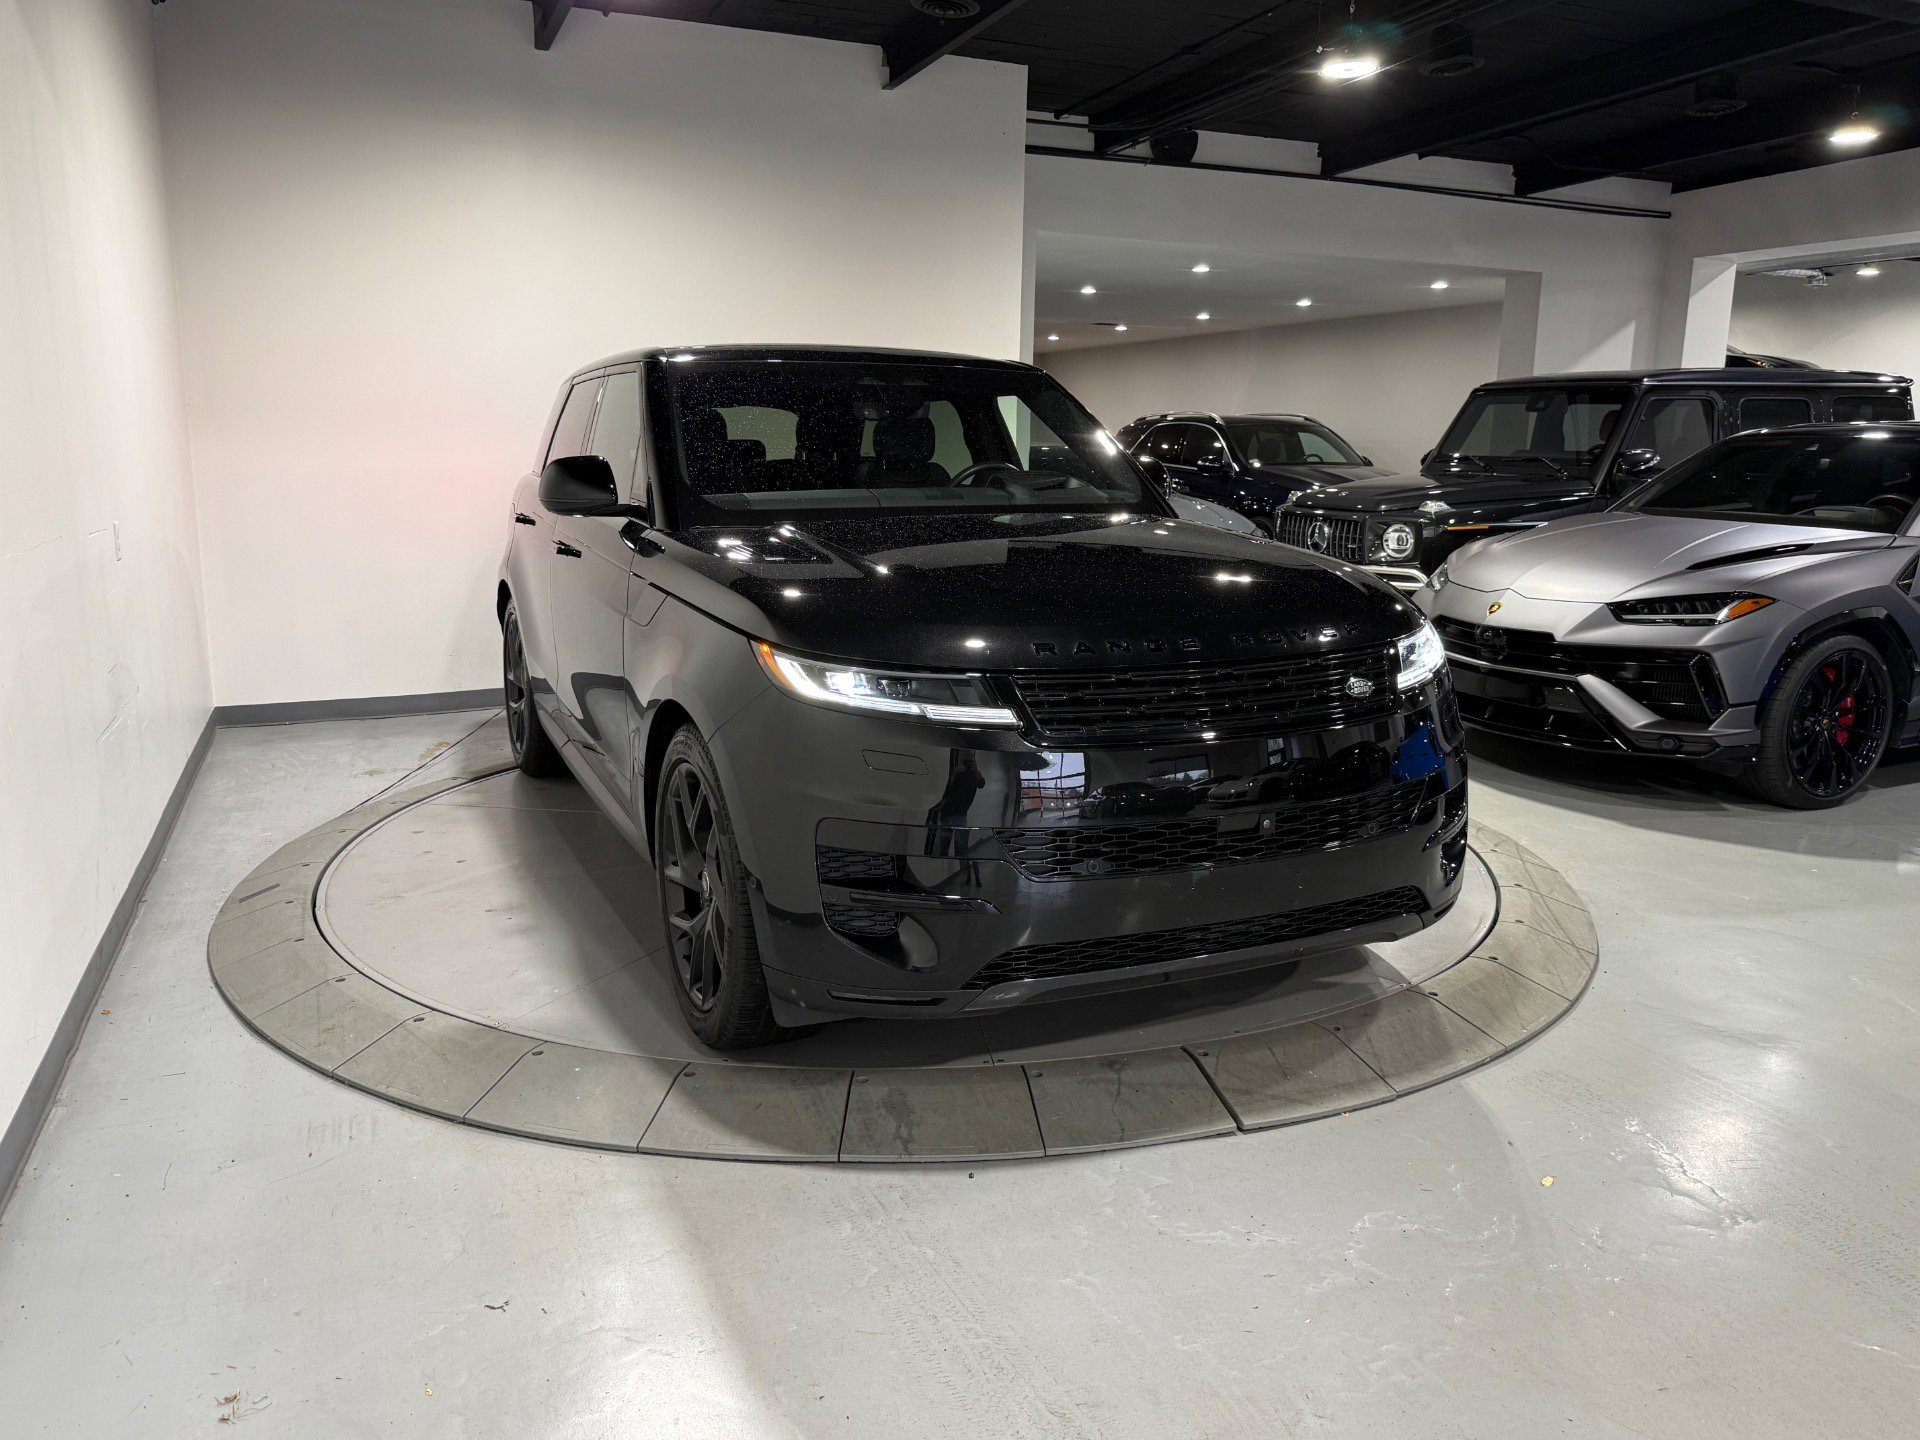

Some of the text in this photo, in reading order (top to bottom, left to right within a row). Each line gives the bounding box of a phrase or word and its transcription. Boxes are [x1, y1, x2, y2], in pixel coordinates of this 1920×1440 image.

[1032, 623, 1362, 656] RANGE ROVER
[1350, 681, 1364, 689] LAND
[1354, 686, 1370, 694] ROVER
